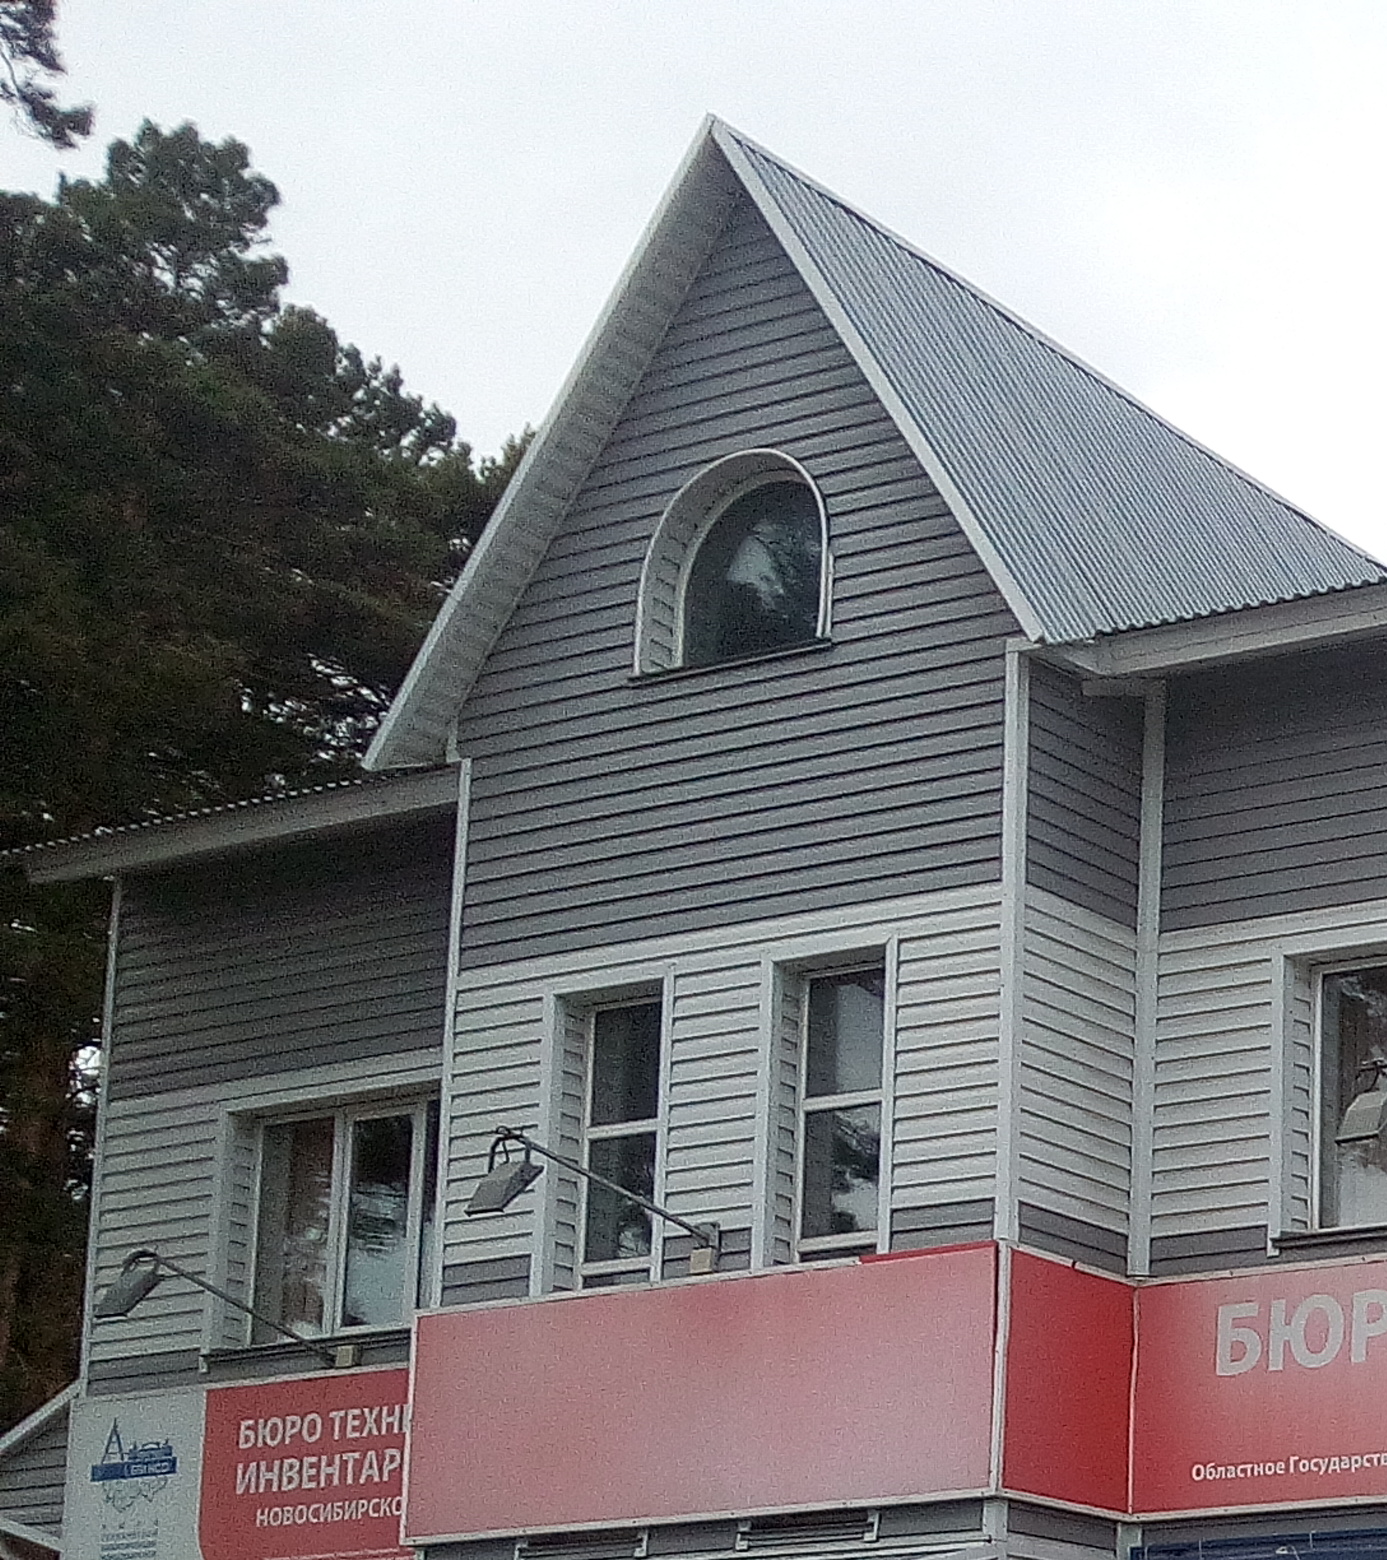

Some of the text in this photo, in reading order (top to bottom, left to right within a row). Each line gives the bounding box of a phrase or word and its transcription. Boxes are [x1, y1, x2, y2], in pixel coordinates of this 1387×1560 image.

[238, 1413, 322, 1449] БЮРО
[235, 1448, 402, 1495] ИНВЕНТАР
[1192, 1460, 1286, 1481] Областное
